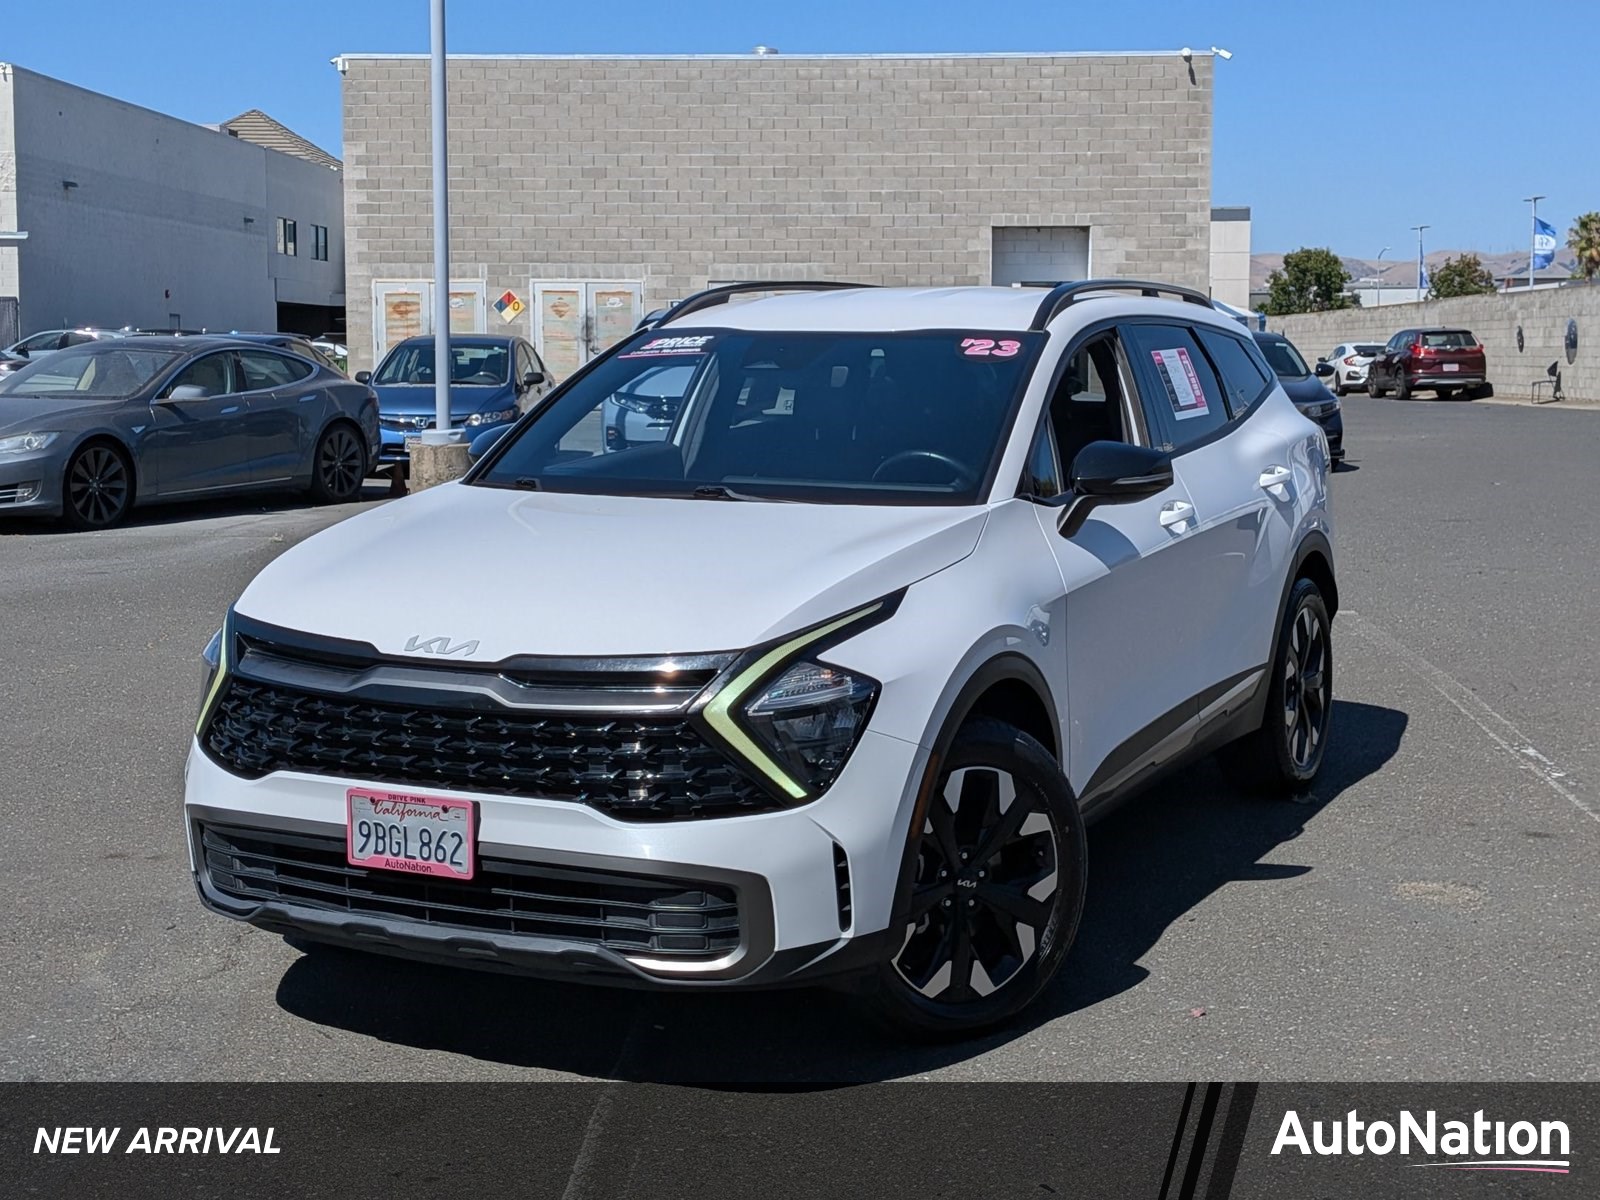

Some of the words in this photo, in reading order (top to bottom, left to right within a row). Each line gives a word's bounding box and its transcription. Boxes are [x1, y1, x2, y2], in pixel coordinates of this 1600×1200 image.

[512, 301, 520, 311] 0
[388, 793, 409, 802] DRIVE
[410, 796, 426, 804] PINK
[373, 799, 448, 823] California
[358, 820, 463, 867] 9BGL862
[384, 859, 433, 874] AutoNation
